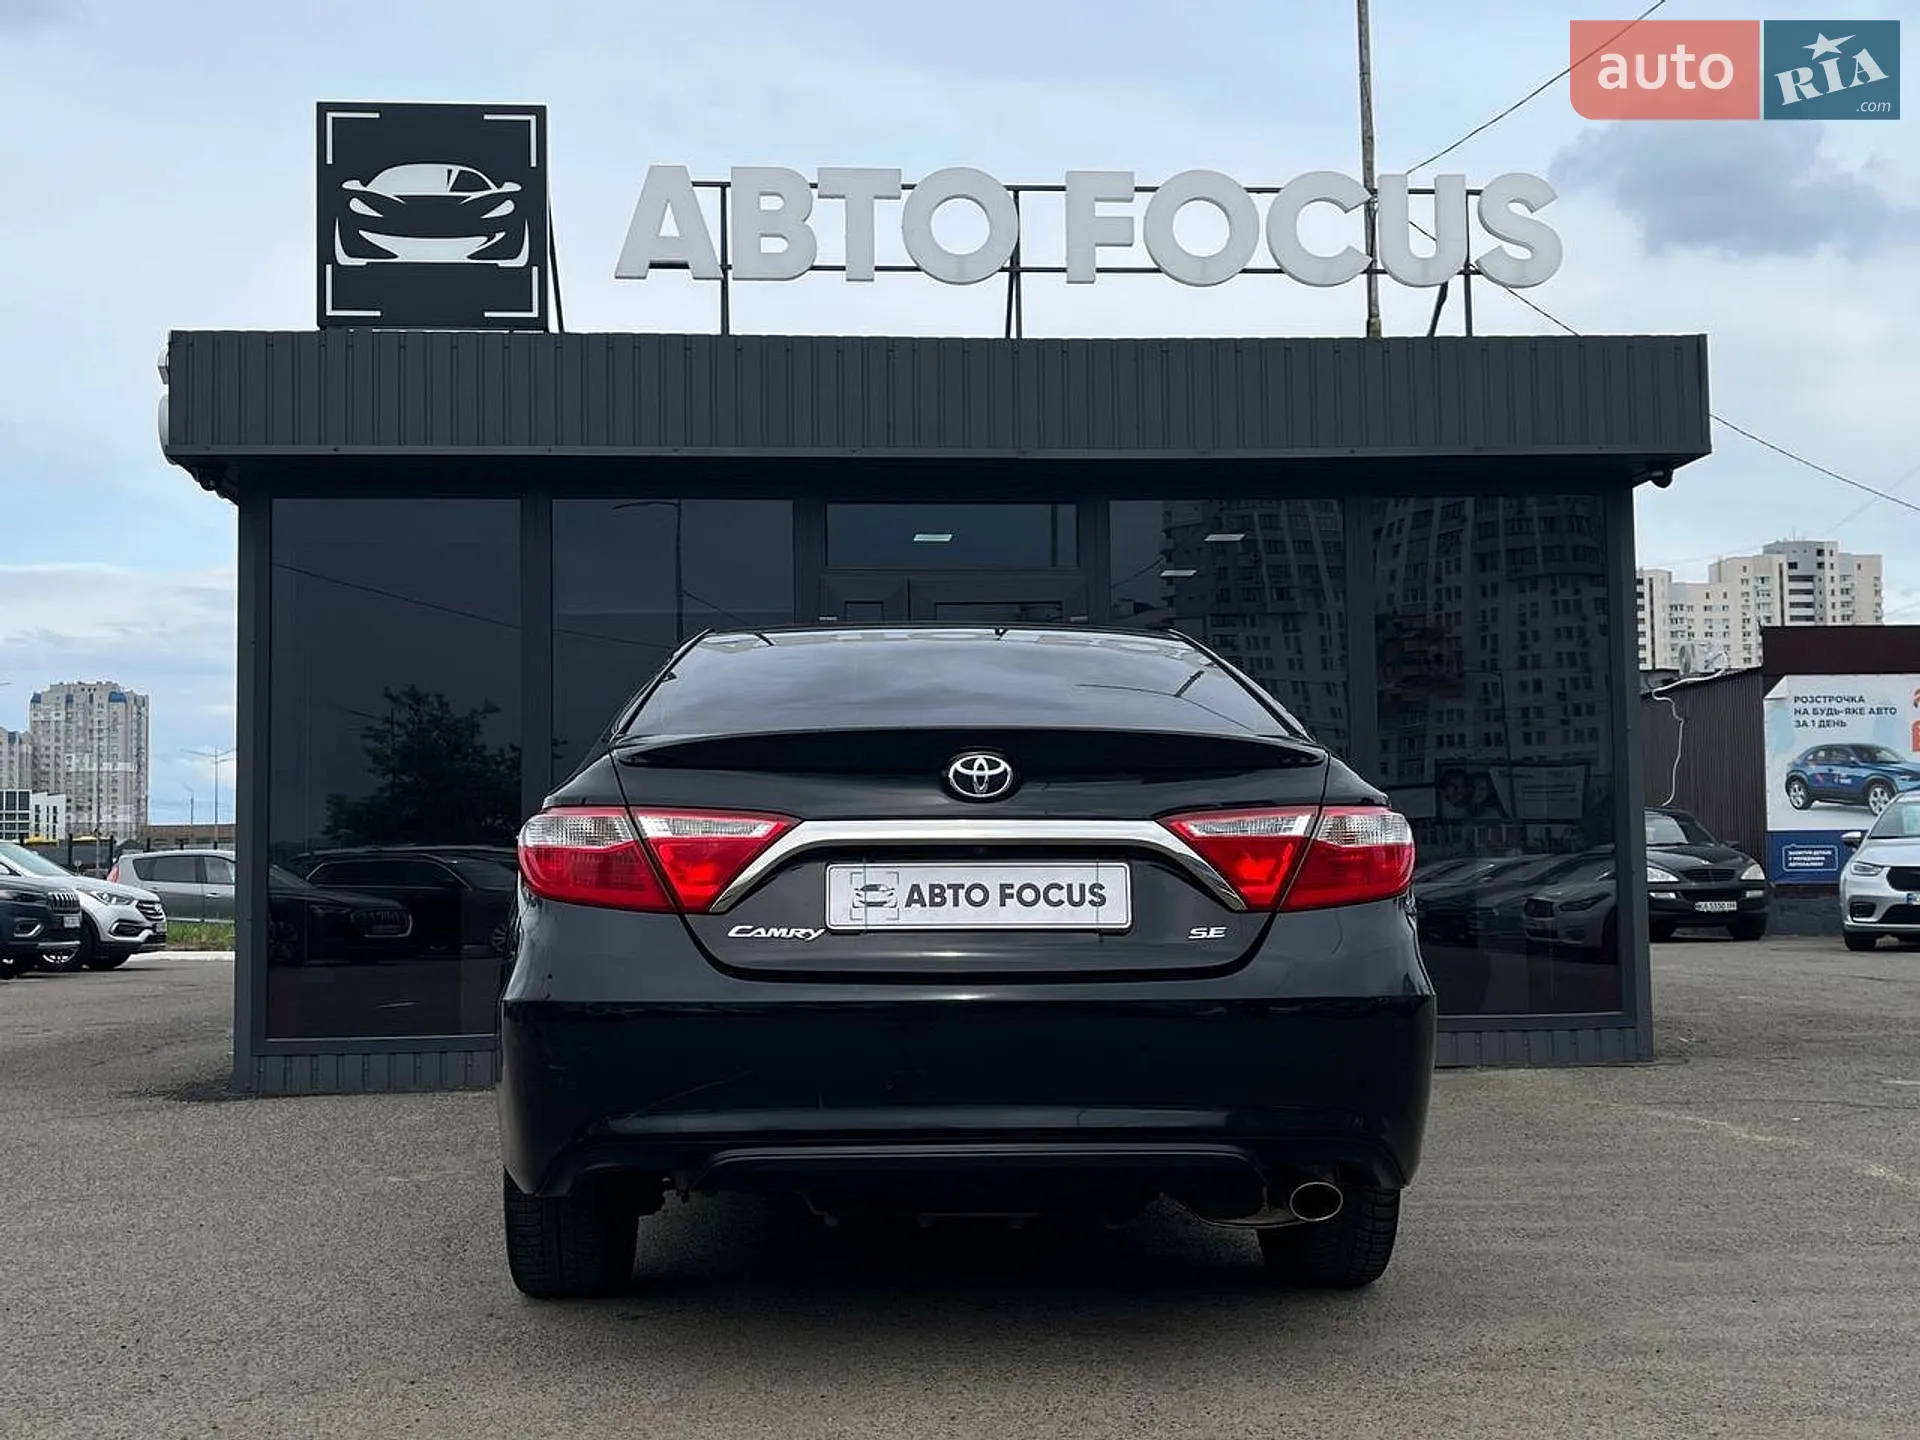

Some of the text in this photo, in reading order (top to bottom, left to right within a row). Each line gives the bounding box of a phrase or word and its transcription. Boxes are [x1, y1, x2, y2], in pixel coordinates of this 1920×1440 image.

[614, 164, 1563, 289] АВТО FOCUS
[1794, 695, 1865, 704] РОЗСТРОЧКА
[1794, 707, 1897, 717] НА БУДЬ-ЯКЕ АВТО
[1795, 719, 1809, 729] ЗА
[1818, 719, 1847, 729] ДЕНЬ
[905, 882, 1108, 908] АВТО FOCUS
[727, 924, 826, 942] CAMRY
[1187, 926, 1227, 940] SE
